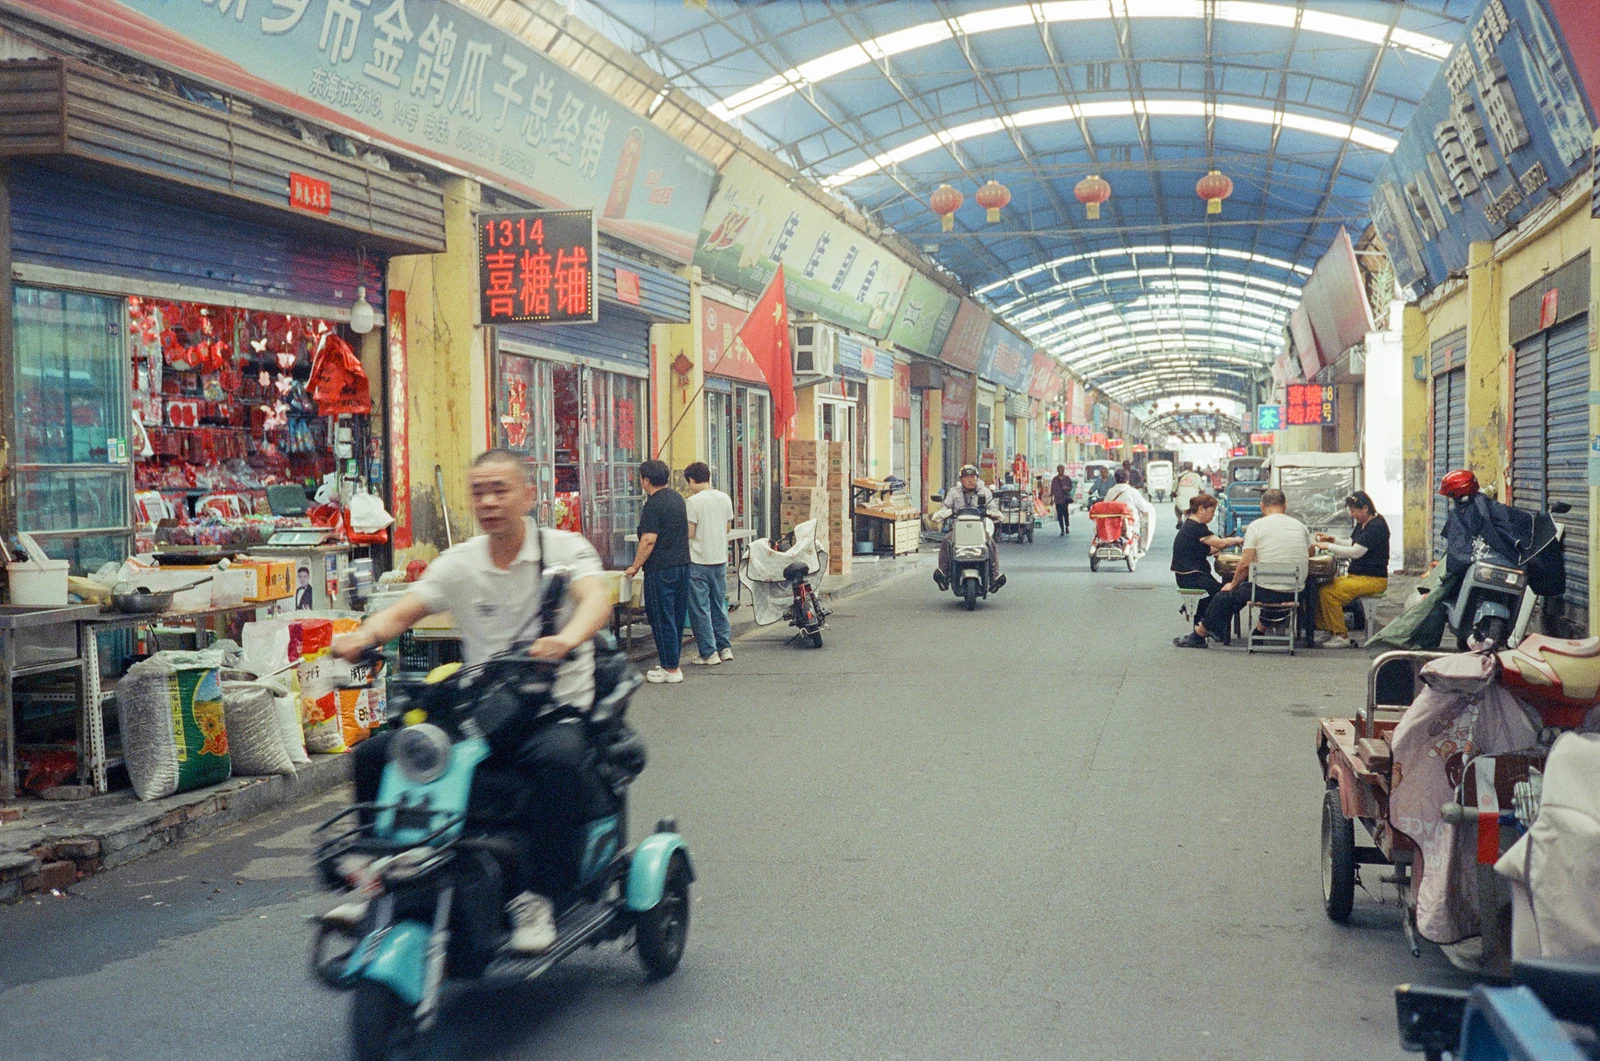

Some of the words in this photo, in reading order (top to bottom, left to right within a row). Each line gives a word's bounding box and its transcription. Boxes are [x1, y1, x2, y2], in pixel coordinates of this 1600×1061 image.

[204, 0, 610, 180] 市金鸽瓜子总经销
[485, 218, 545, 247] 1314
[485, 245, 590, 318] 喜糖铺
[1259, 407, 1279, 429] 茶
